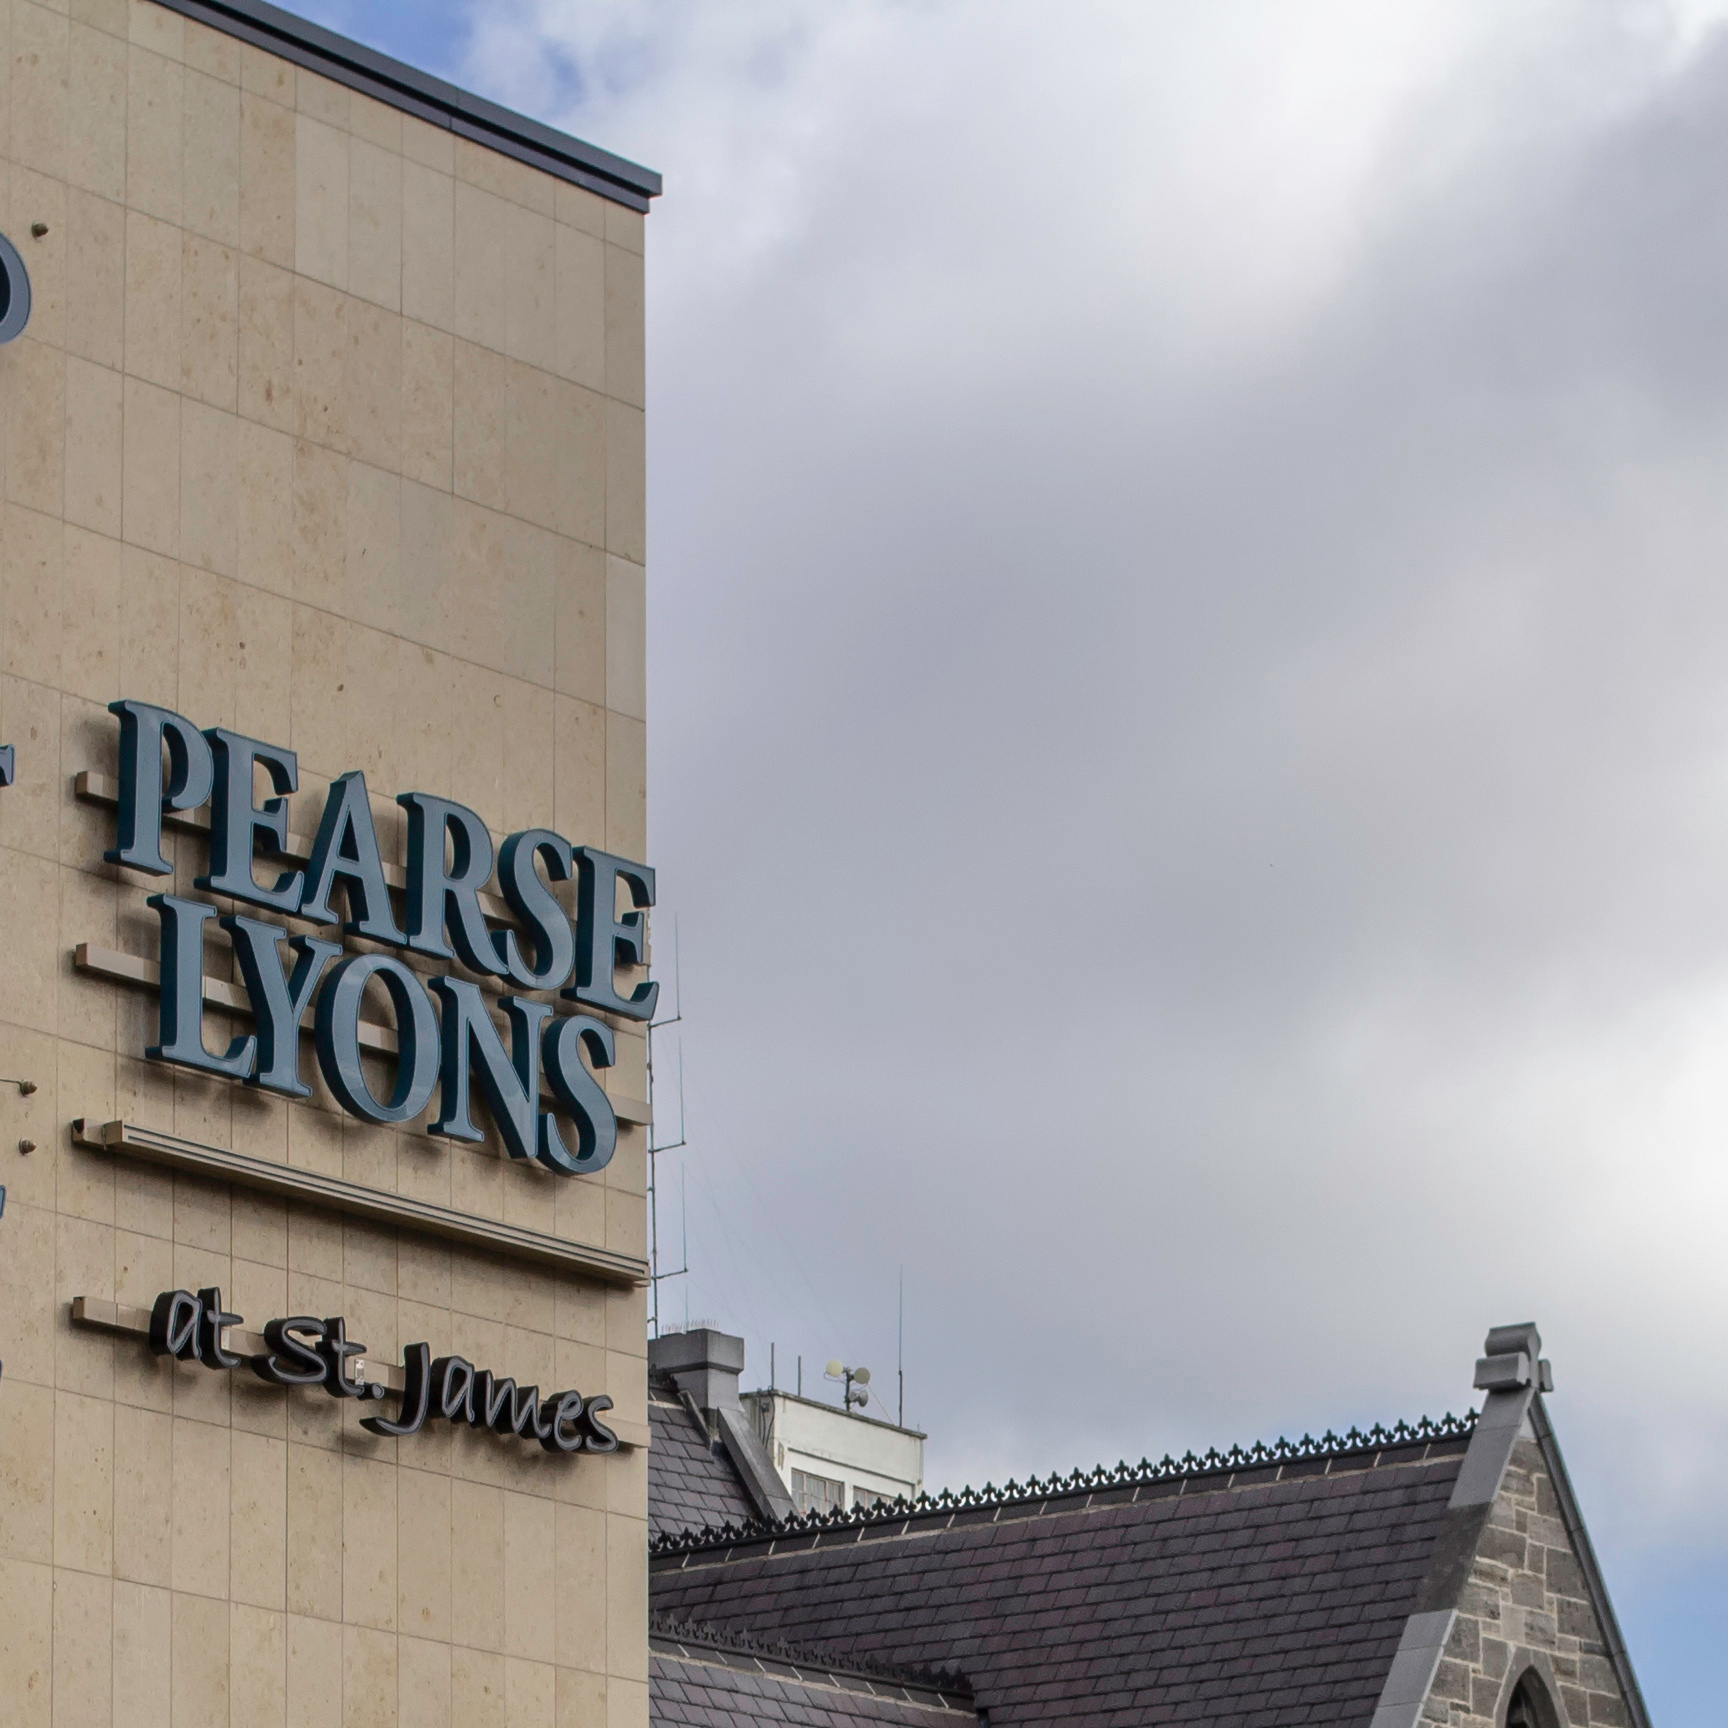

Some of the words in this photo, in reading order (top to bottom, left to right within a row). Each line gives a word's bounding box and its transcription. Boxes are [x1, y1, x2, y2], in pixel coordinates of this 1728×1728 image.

[104, 699, 660, 1021] PEARSE
[145, 893, 618, 1176] LYONS
[149, 1286, 244, 1370] at
[250, 1316, 385, 1400] St.
[359, 1341, 619, 1454] James
